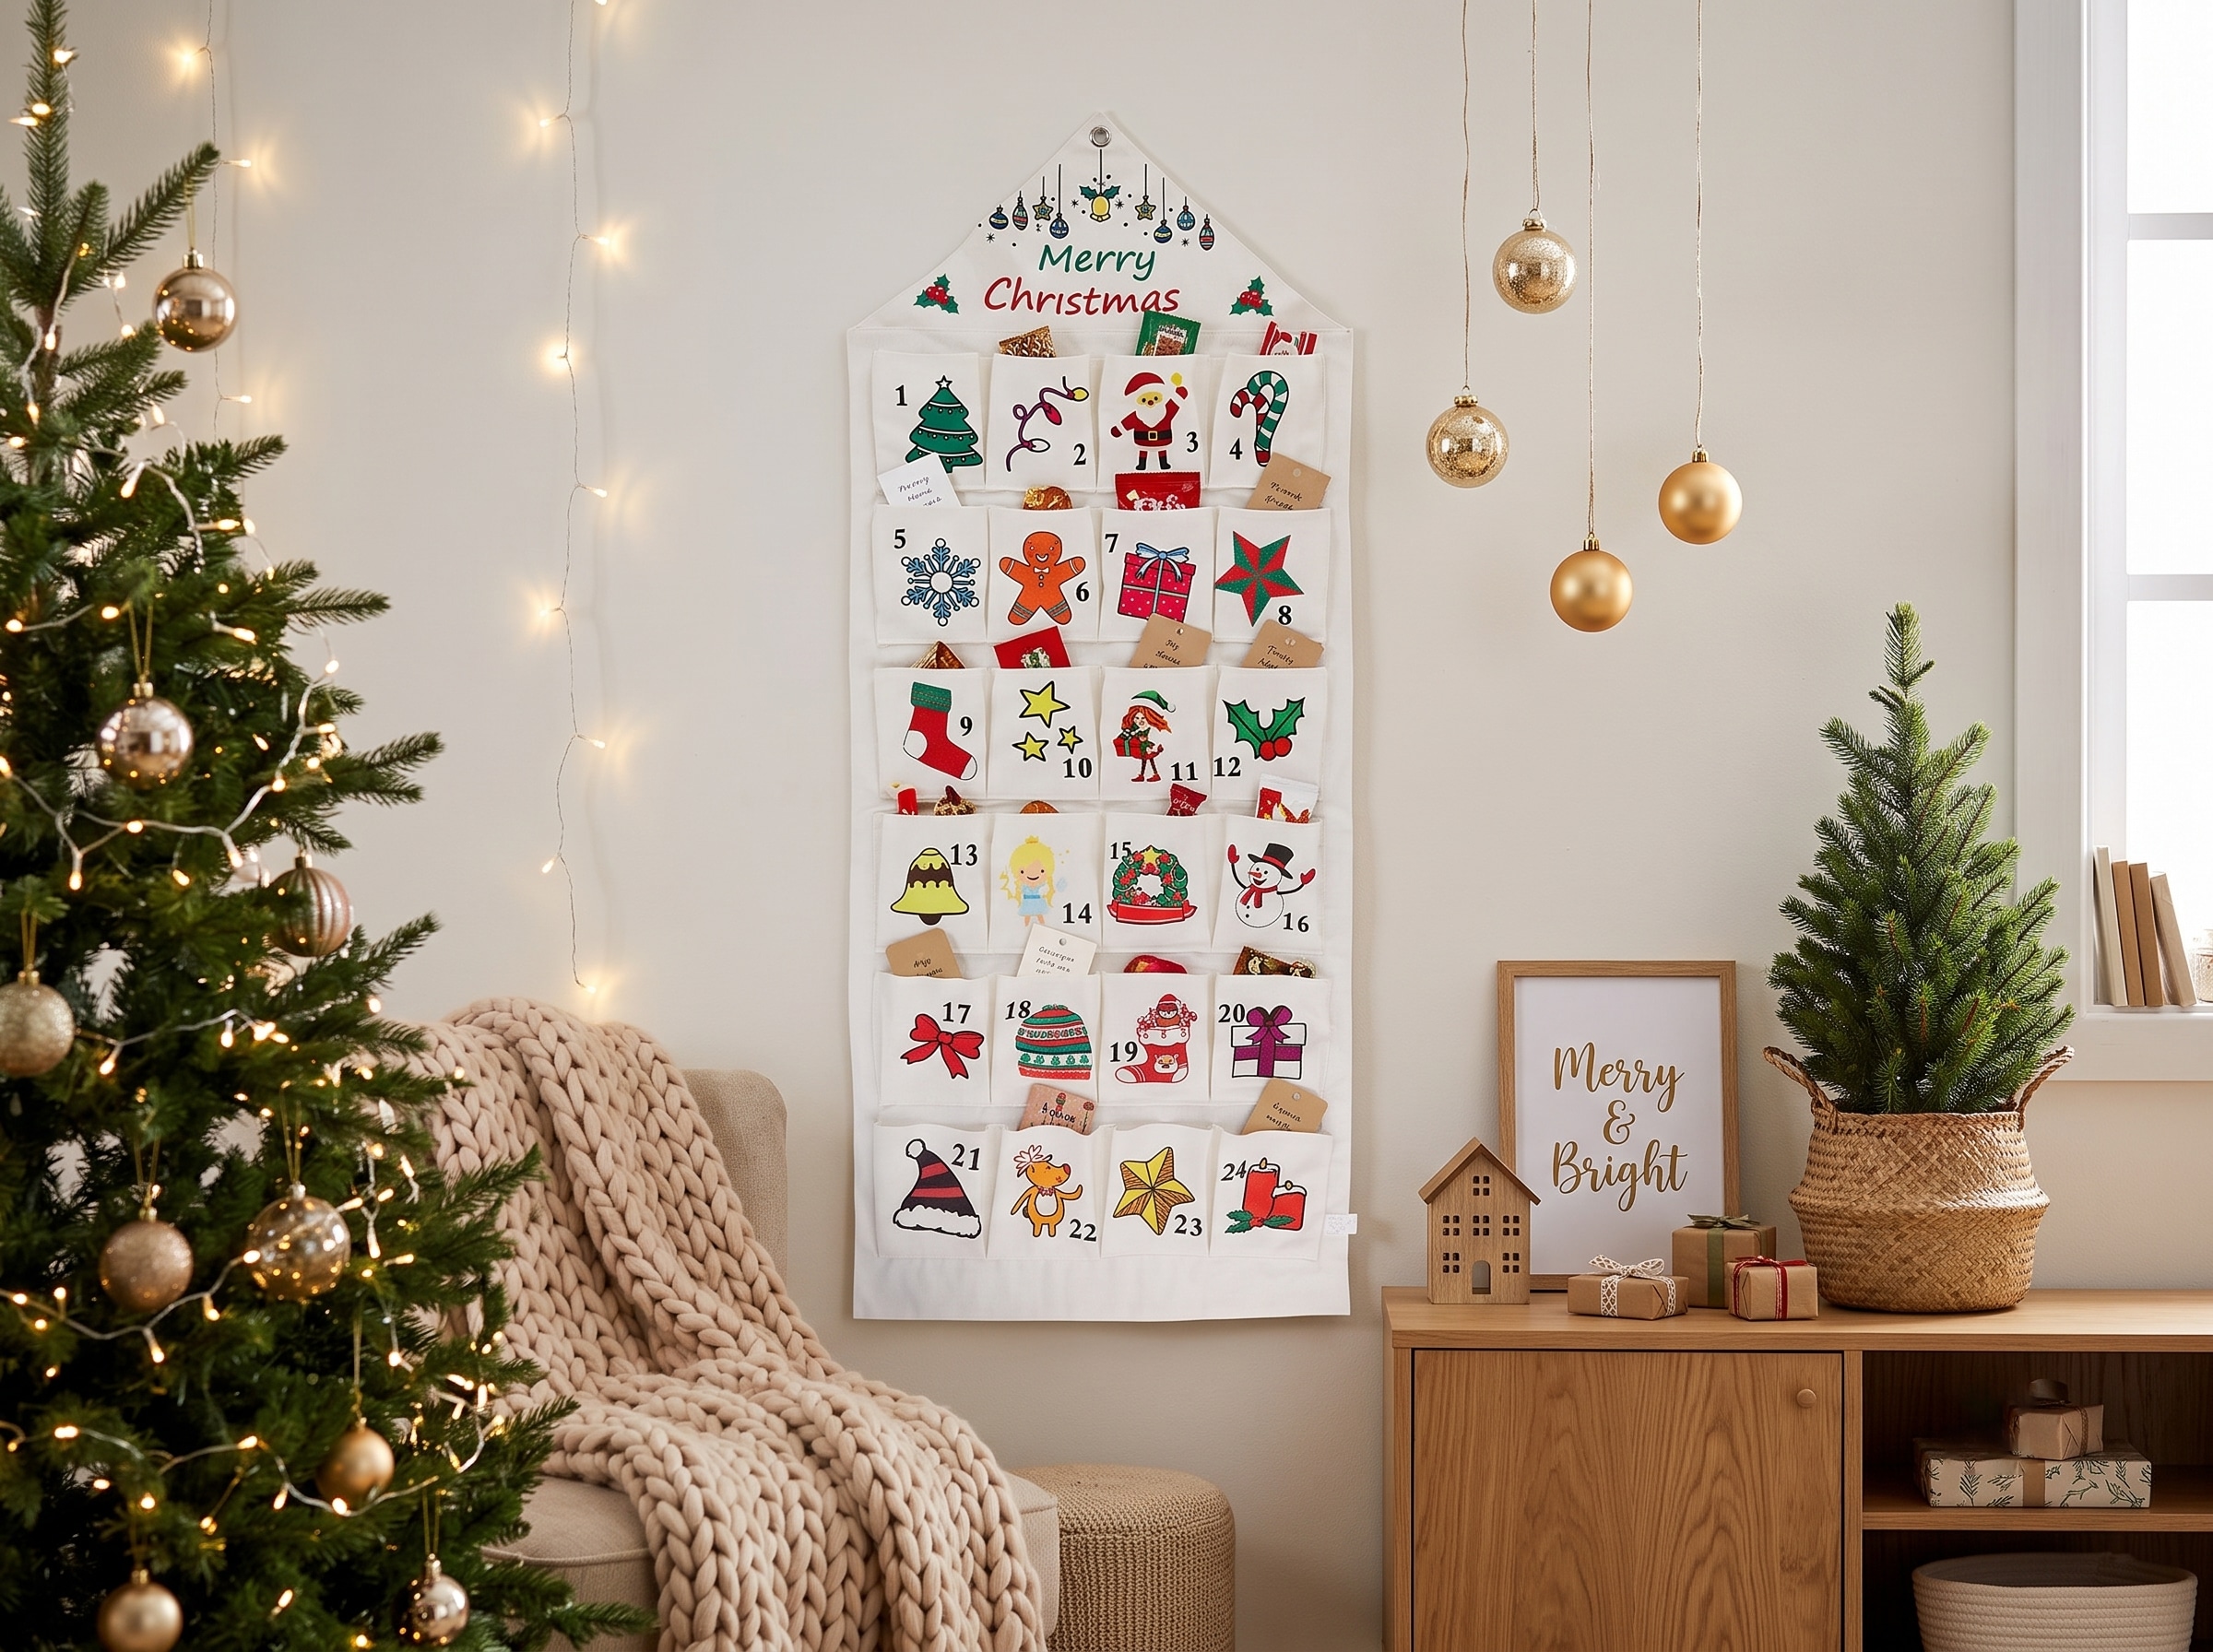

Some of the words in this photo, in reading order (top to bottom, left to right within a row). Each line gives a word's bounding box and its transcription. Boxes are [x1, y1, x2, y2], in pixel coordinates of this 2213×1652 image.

[1038, 243, 1155, 282] Merry
[984, 276, 1180, 315] Christmas
[895, 384, 908, 407] 1
[1186, 431, 1199, 453] 3
[1229, 437, 1243, 460] 4
[1073, 442, 1087, 466] 2
[893, 528, 906, 549] 5
[1105, 533, 1119, 553] 7
[1075, 581, 1090, 602] 6
[1278, 605, 1292, 626] 8
[960, 715, 973, 737] 9
[1062, 757, 1093, 779] 10
[1170, 761, 1199, 782] 11
[1213, 756, 1241, 777] 12
[950, 844, 978, 867] 13
[1110, 841, 1133, 862] 15
[1062, 903, 1093, 924] 14
[1283, 912, 1309, 933] 16
[942, 1001, 972, 1024] 17
[1005, 1000, 1032, 1021] 18
[1218, 1003, 1246, 1023] 20
[1109, 1041, 1138, 1063] 19
[1554, 1042, 1685, 1114] Merry
[1603, 1100, 1636, 1145] &
[951, 1143, 980, 1171] 21
[1221, 1160, 1247, 1182] 24
[1553, 1139, 1687, 1212] Bright
[1069, 1218, 1097, 1242] 22
[1174, 1213, 1202, 1237] 23
